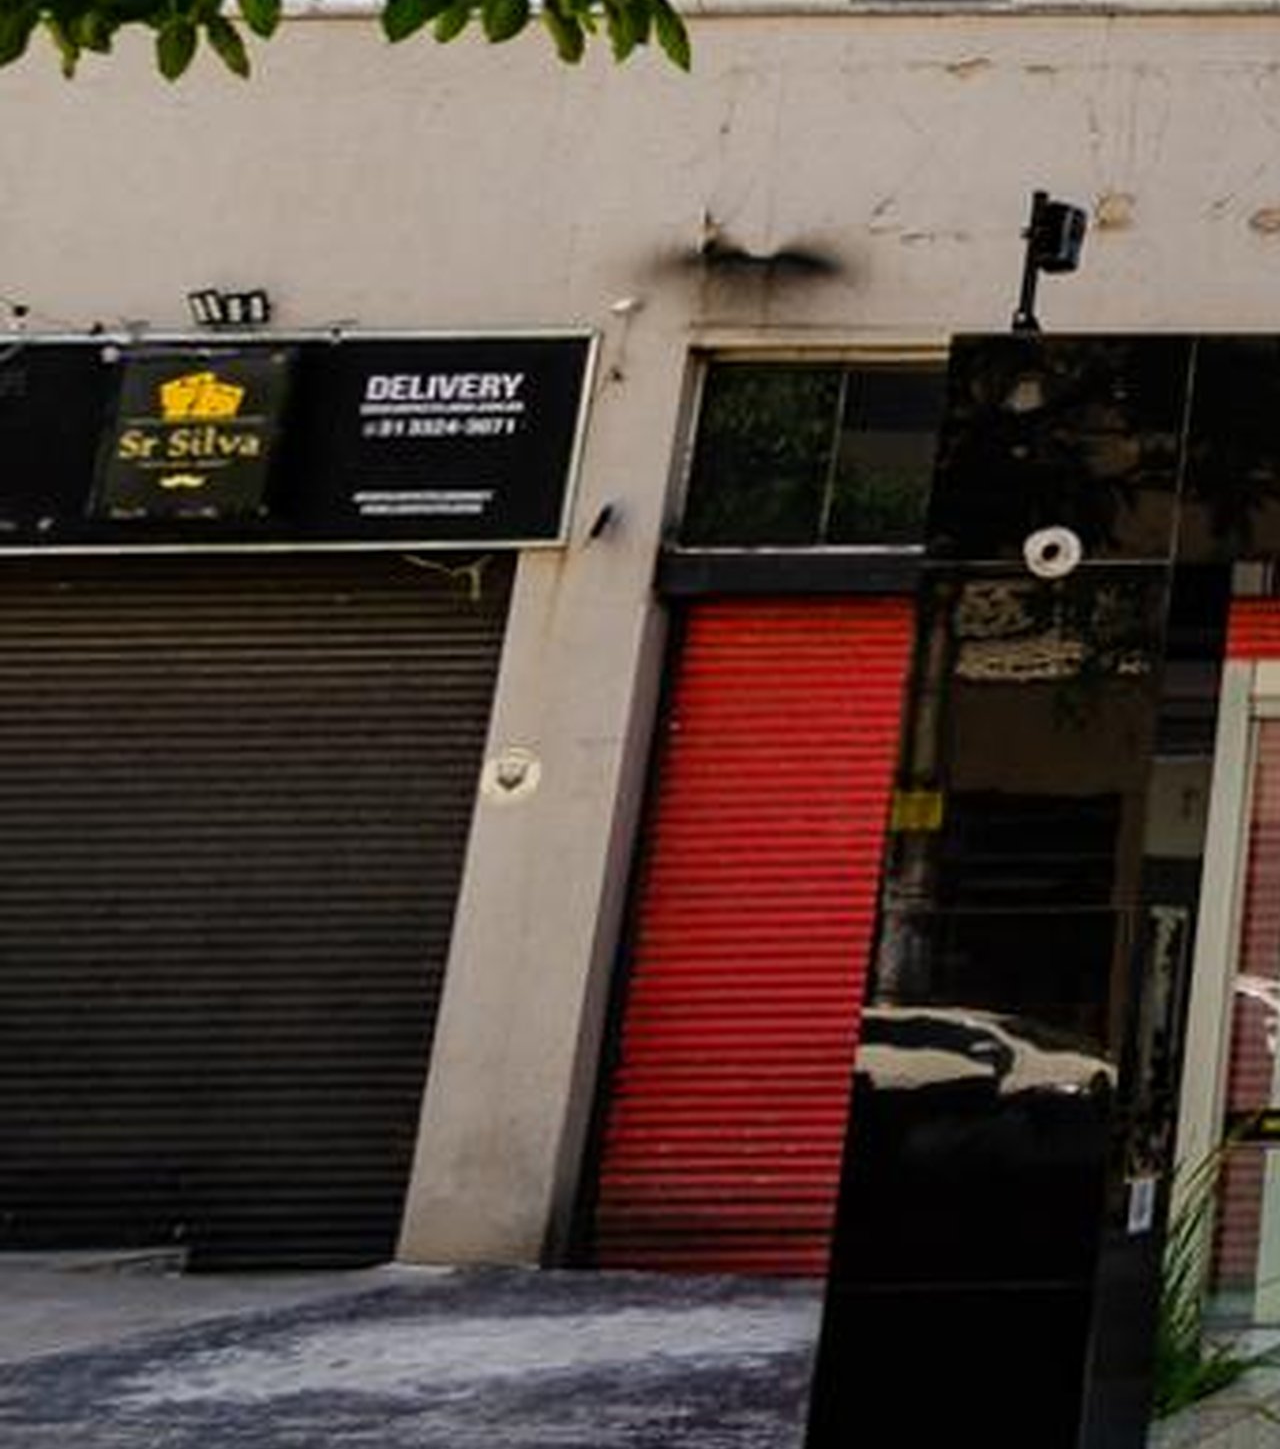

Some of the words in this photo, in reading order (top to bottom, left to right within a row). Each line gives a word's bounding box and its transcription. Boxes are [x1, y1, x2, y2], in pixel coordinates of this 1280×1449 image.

[365, 373, 524, 401] DELIVERY
[118, 430, 160, 458] Sr
[167, 426, 261, 457] Silva
